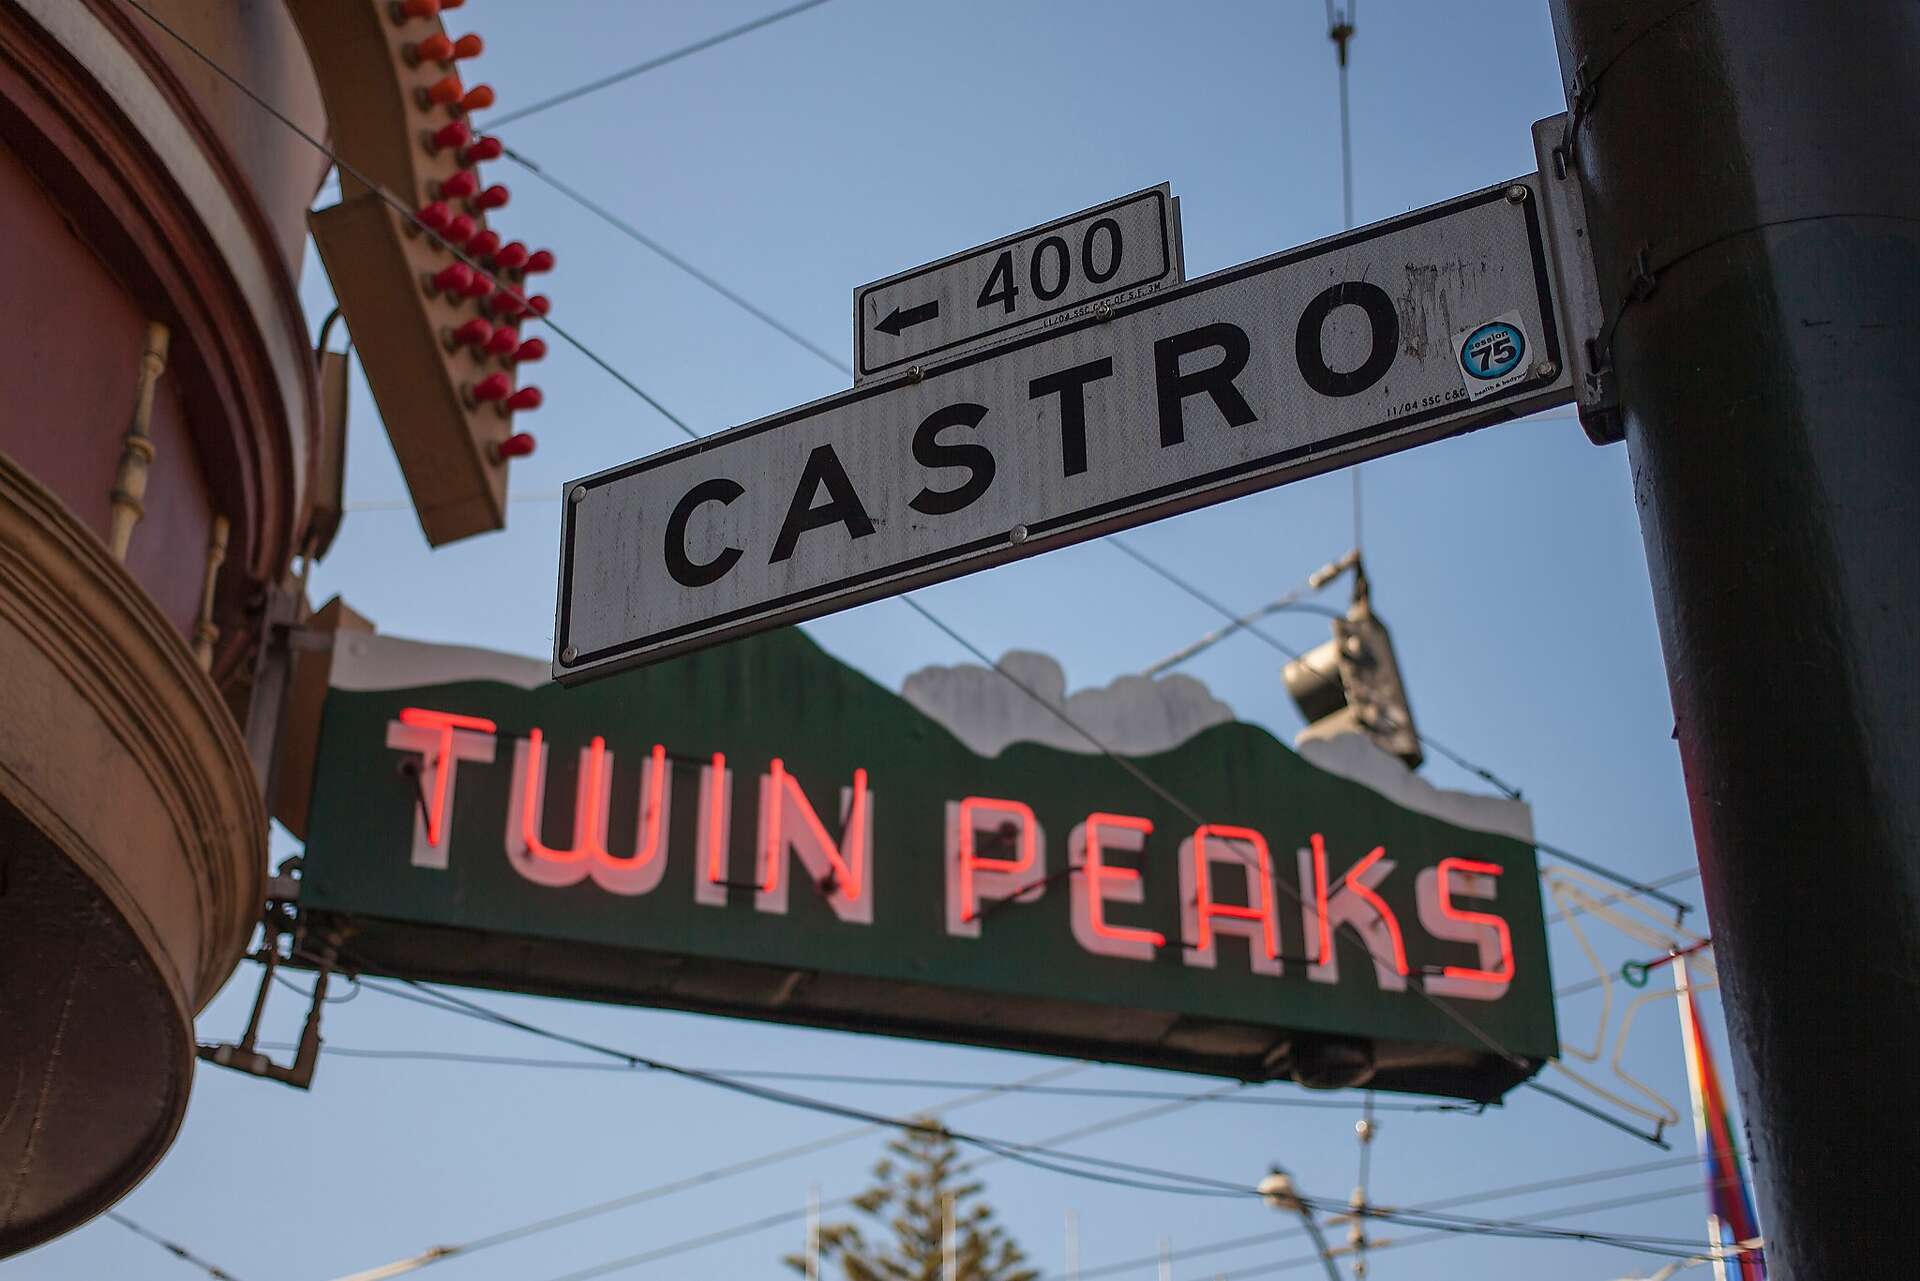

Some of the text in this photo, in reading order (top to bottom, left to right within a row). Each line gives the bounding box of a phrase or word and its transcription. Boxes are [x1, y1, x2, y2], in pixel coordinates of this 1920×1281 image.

[976, 218, 1122, 314] 400
[1114, 294, 1125, 305] OF
[1148, 282, 1161, 295] 3M
[1470, 331, 1508, 349] session
[1471, 337, 1516, 372] 75
[1386, 387, 1466, 417] 11/04 SSC C&C
[663, 281, 1400, 587] CASTRO
[386, 708, 1515, 1000] TWIN PEAKS
